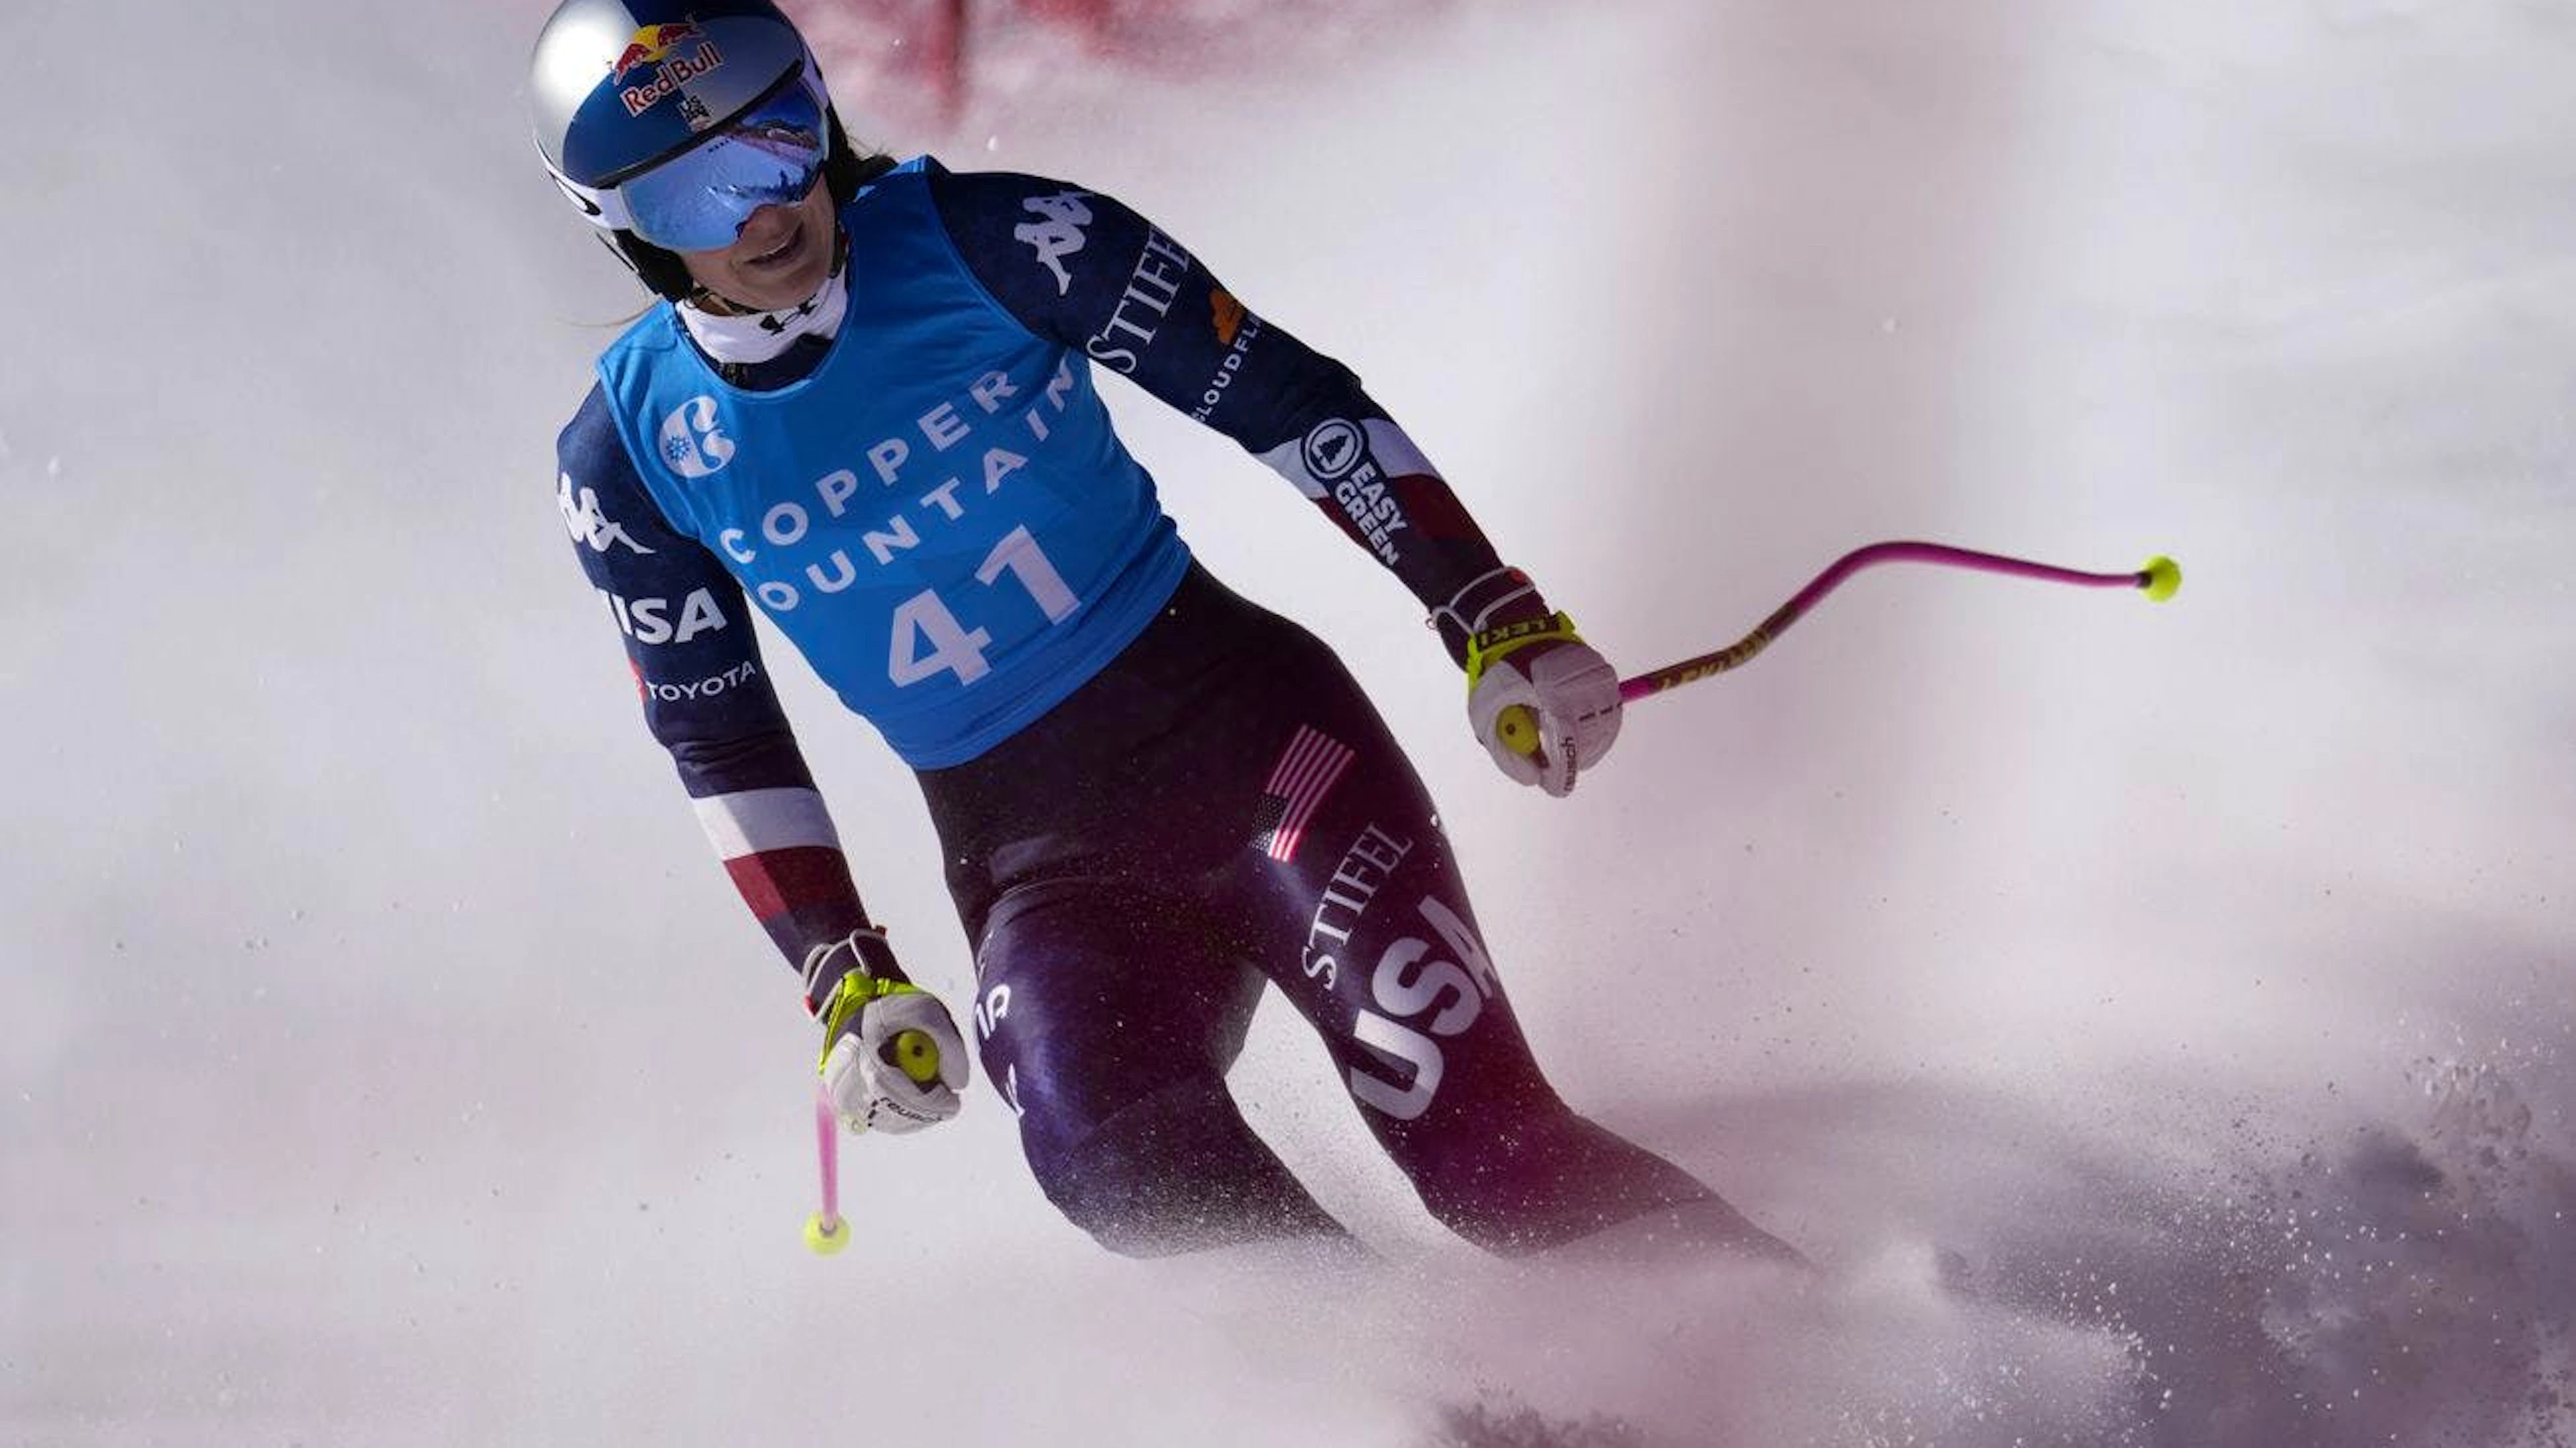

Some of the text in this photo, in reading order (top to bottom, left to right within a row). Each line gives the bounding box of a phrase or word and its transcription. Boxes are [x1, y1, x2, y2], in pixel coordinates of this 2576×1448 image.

[619, 40, 724, 118] Red Bull
[1086, 225, 1191, 374] STIFE
[720, 370, 1020, 565] COPPER
[756, 346, 1075, 612] OUNTAIN
[1334, 479, 1400, 566] GREEN
[1350, 460, 1409, 534] EASY
[645, 660, 757, 702] TOYOTA
[889, 524, 1081, 689] 41
[1301, 821, 1415, 992] STIFEL
[1350, 894, 1499, 1121] USA
